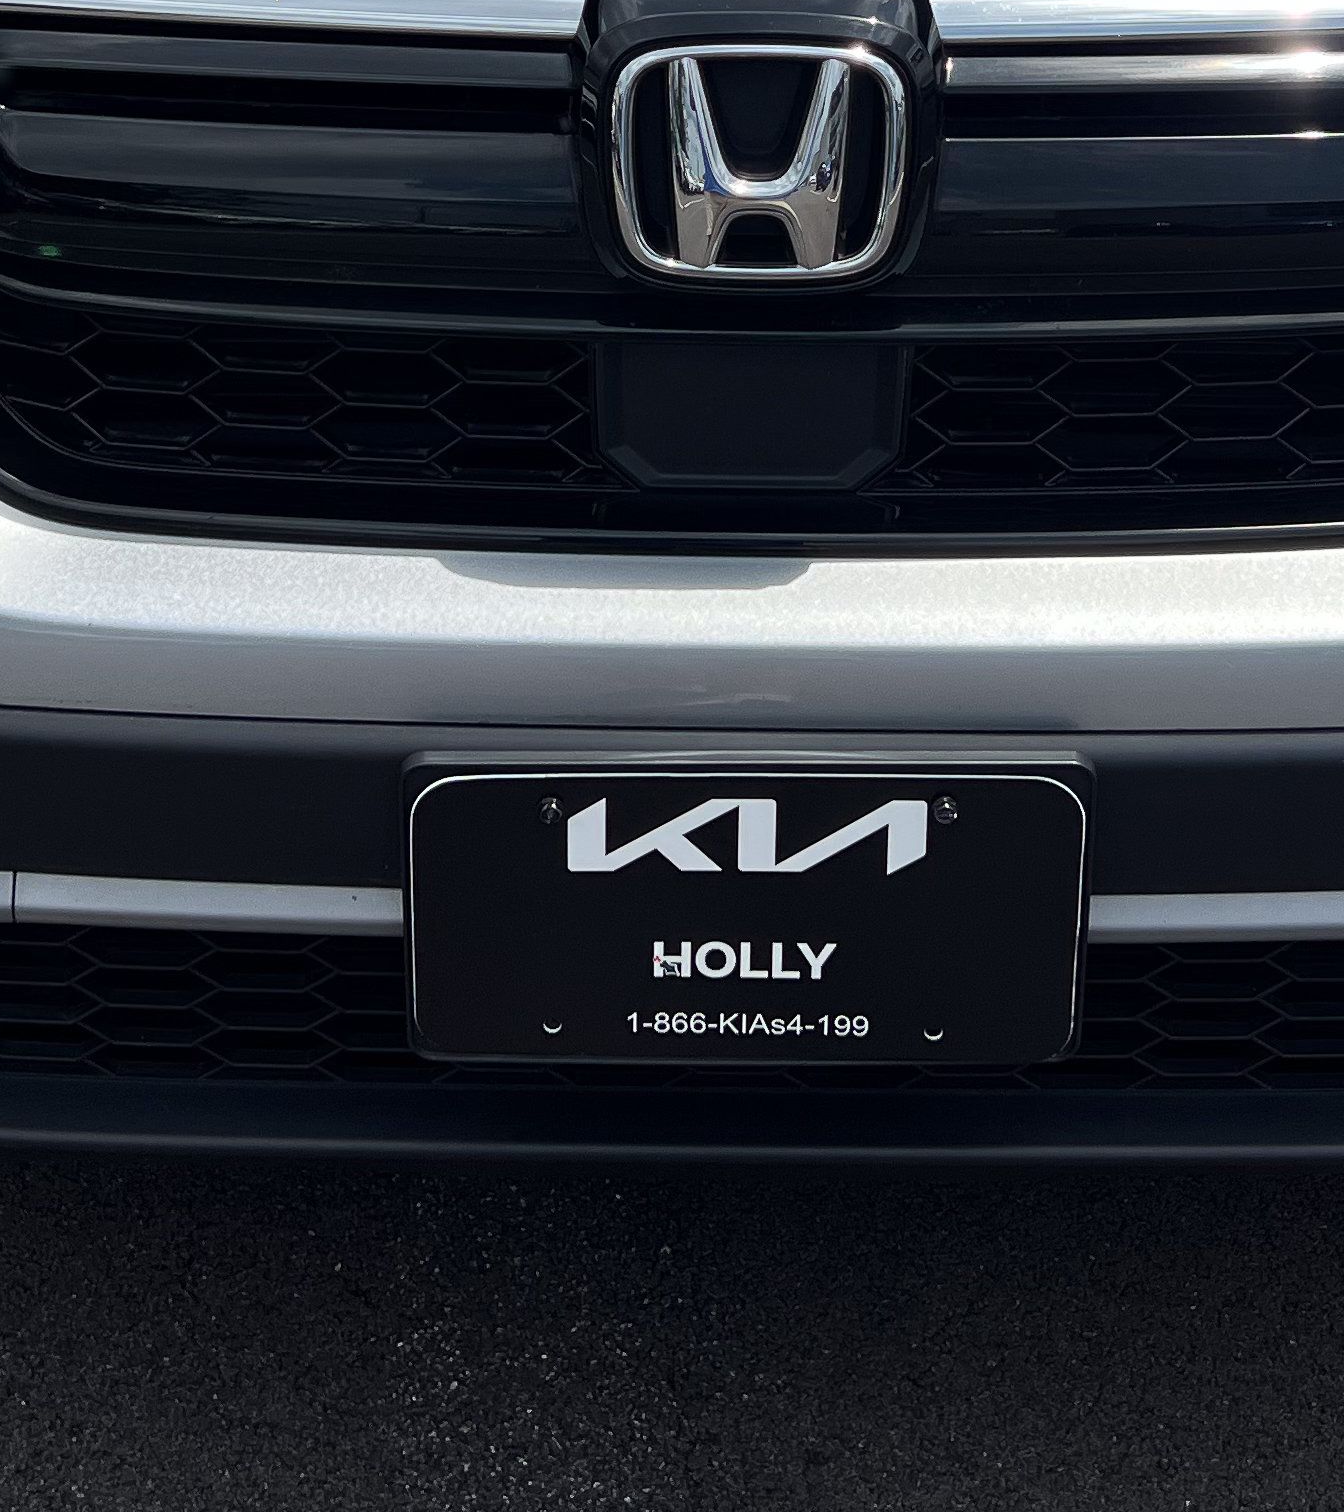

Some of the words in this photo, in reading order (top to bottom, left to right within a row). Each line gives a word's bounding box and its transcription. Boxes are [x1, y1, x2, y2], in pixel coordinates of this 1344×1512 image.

[567, 797, 927, 875] KIA
[652, 940, 837, 980] HOLLY
[626, 1010, 870, 1039] 1-866-KIAs4-199
